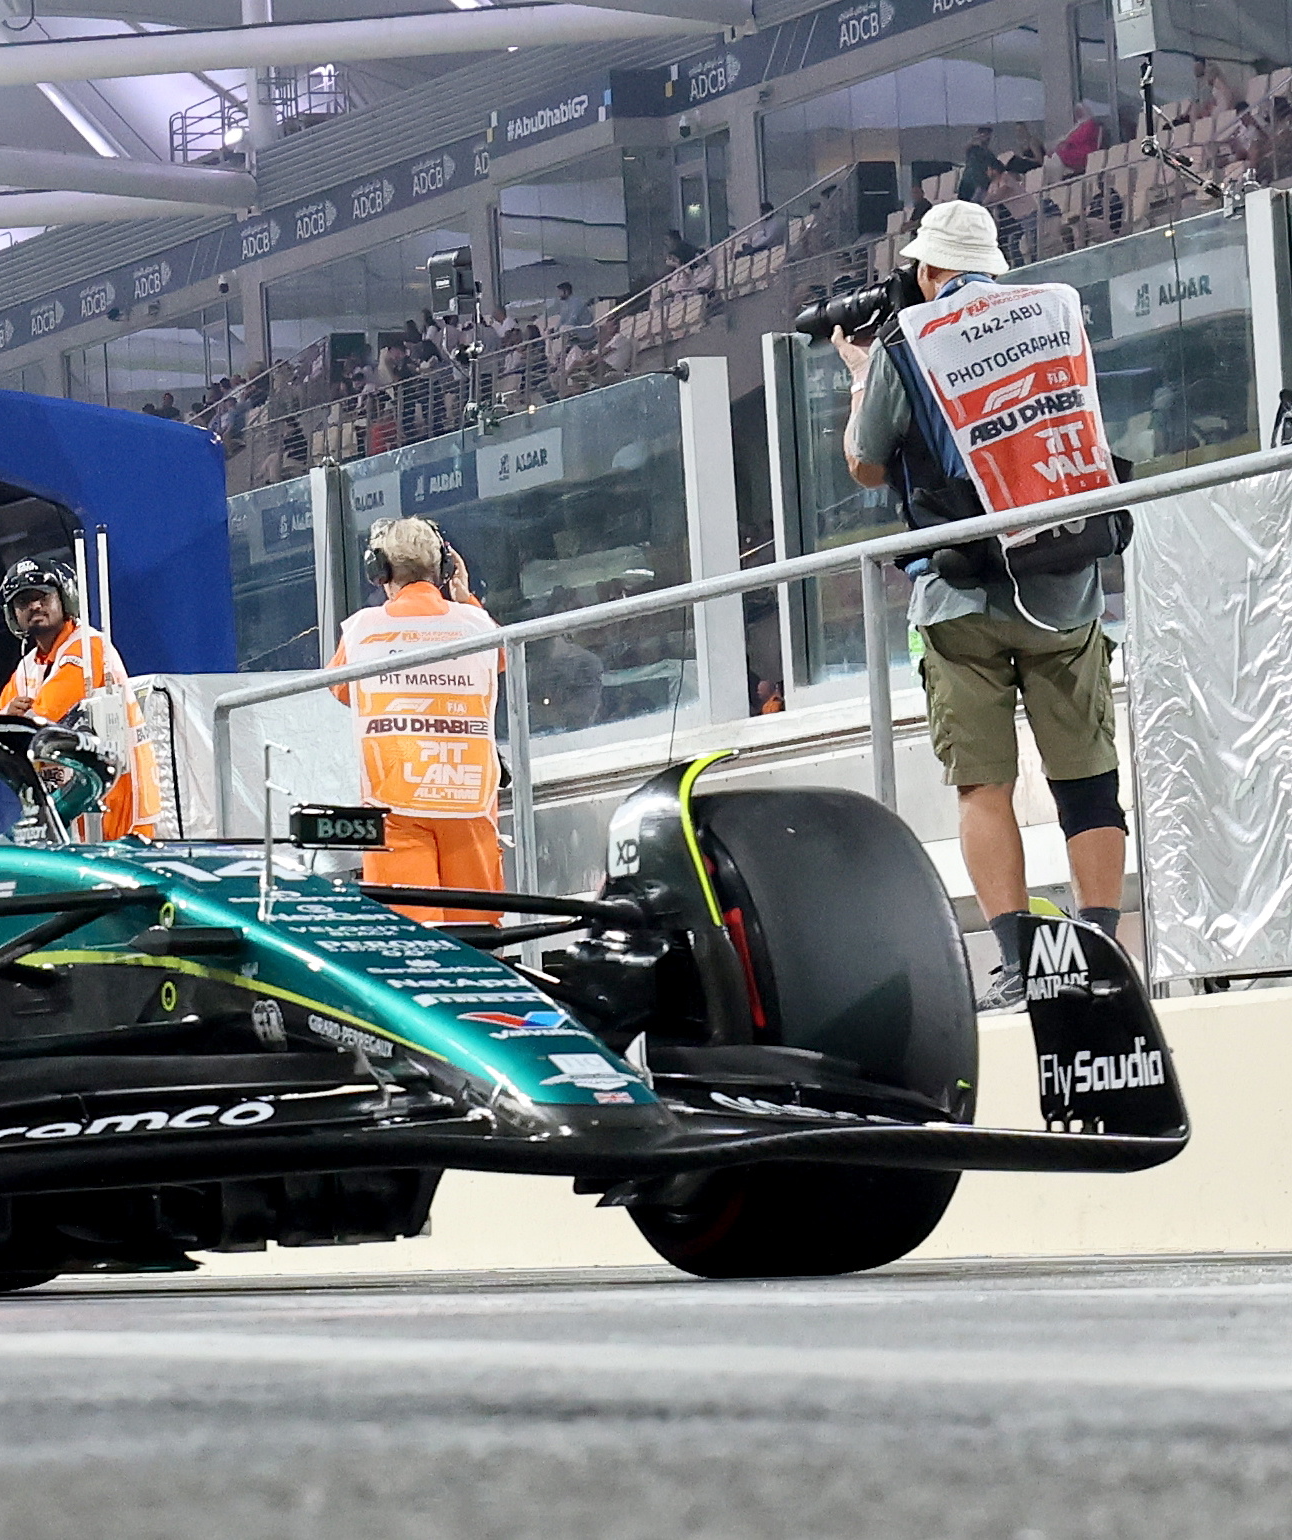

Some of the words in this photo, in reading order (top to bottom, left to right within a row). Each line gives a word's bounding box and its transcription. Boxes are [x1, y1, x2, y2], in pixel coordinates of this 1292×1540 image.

[839, 13, 879, 48] ADCB
[689, 69, 726, 101] ADCB
[412, 166, 443, 197] ADCB
[352, 191, 382, 220] ADCB
[296, 212, 325, 239] ADCB
[242, 234, 270, 260] ADCB
[134, 272, 161, 299] ADCB
[1158, 274, 1212, 306] ALDAR
[80, 292, 106, 317] ADCB
[30, 314, 56, 336] ADCB
[961, 302, 1043, 344] 1242-ABU
[970, 410, 1018, 446] ABU
[379, 674, 402, 685] PIT
[405, 674, 475, 687] MARSHAL
[365, 718, 408, 735] ABU
[410, 718, 468, 735] DHABI
[416, 740, 468, 763] PIT
[403, 762, 483, 786] LANE
[317, 818, 377, 840] BOSS
[1039, 1035, 1166, 1107] FlySaudia
